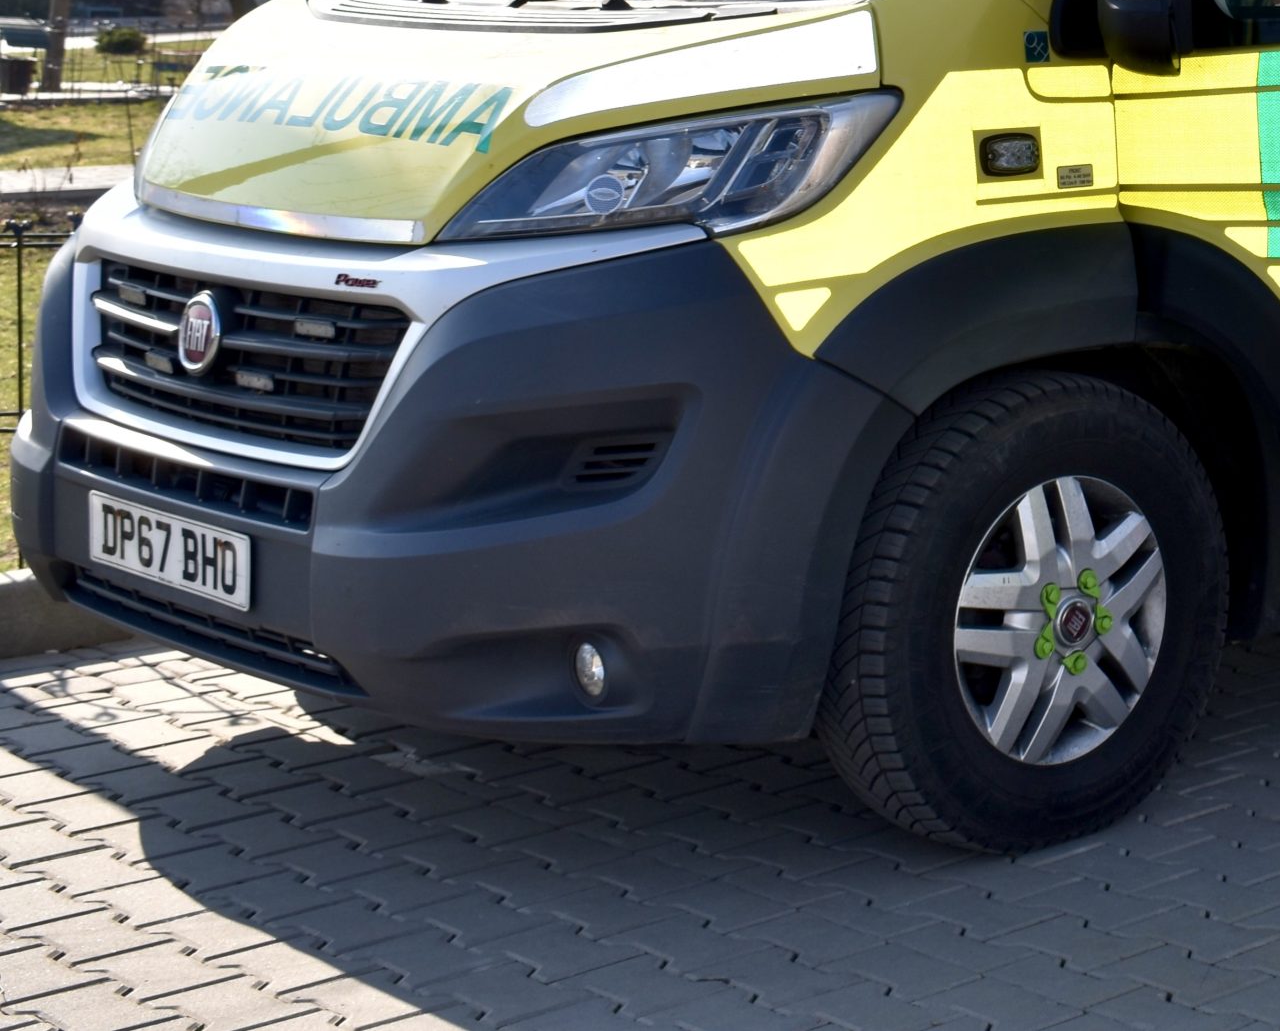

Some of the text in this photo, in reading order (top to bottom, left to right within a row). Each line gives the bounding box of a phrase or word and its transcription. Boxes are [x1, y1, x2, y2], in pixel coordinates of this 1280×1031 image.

[185, 317, 210, 352] FIAT
[102, 503, 237, 596] DP67 BHO
